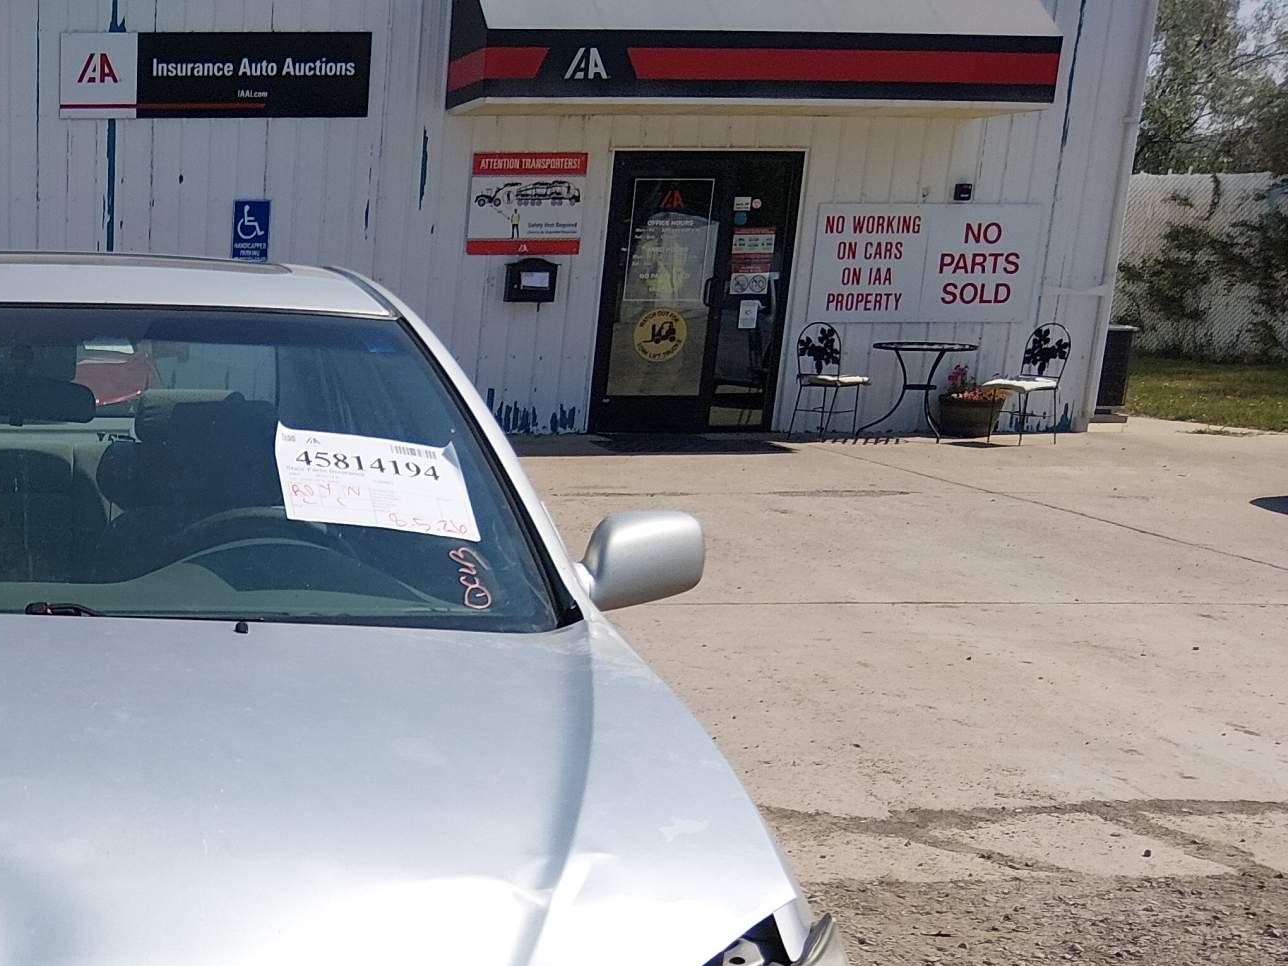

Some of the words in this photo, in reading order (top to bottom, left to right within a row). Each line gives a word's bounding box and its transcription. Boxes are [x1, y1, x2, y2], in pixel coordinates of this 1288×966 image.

[152, 58, 234, 77] Insurance
[238, 58, 278, 76] Auto
[282, 57, 356, 76] Auctions
[480, 158, 520, 169] ATTENTION
[522, 157, 581, 169] TRANSPORTERS!
[825, 215, 845, 234] NO
[852, 215, 922, 234] WORKING
[964, 222, 1002, 244] NO
[837, 241, 857, 260] ON
[864, 241, 903, 260] CARS
[938, 252, 1021, 275] PARTS
[841, 267, 861, 286] ON
[867, 267, 893, 286] IAA
[825, 293, 903, 312] PROPERTY
[940, 282, 1012, 304] SOLD
[295, 450, 440, 481] 45814194
